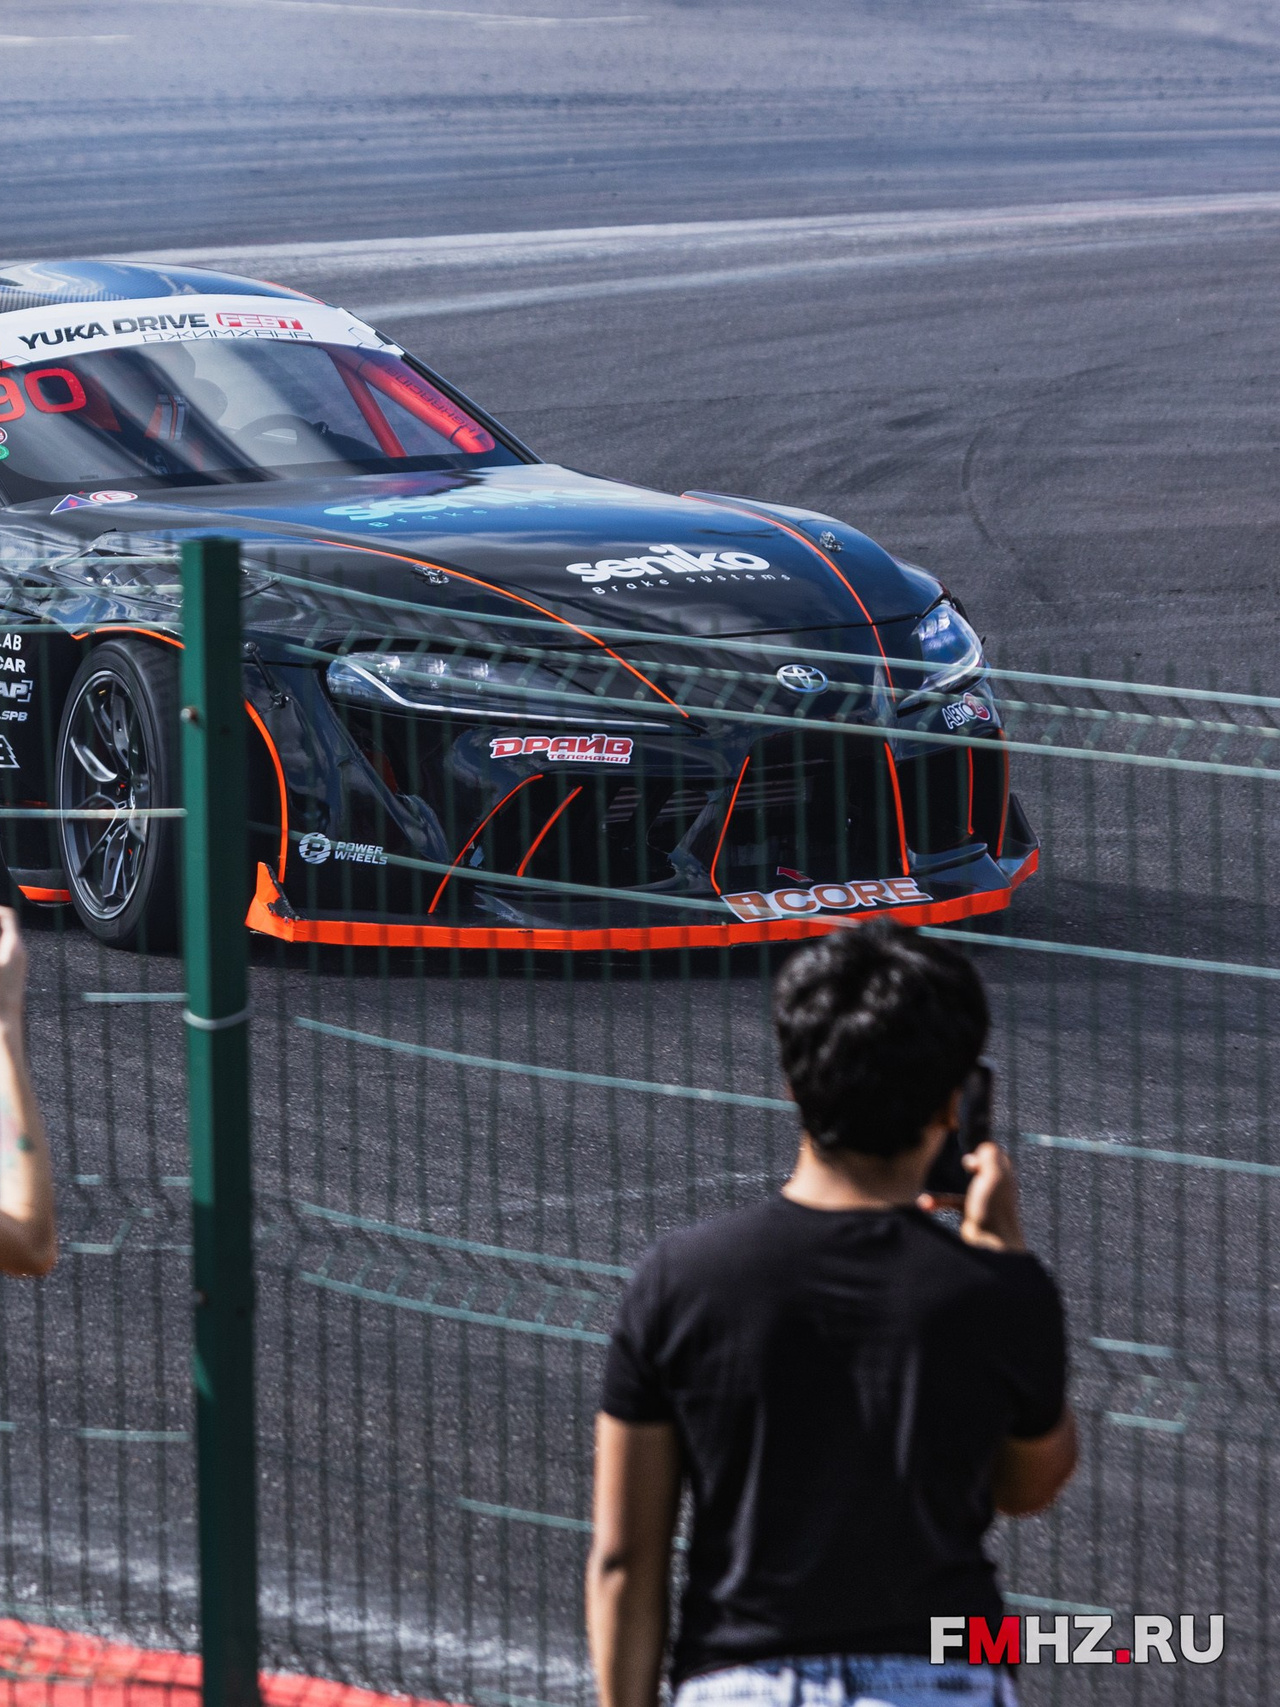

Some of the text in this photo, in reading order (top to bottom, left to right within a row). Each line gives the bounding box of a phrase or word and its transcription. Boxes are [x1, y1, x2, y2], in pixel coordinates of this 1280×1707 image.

[18, 313, 299, 350] YUKA DRIVE FEST
[141, 328, 314, 342] ДЖИМХАНА
[368, 509, 488, 528] Brake
[566, 544, 771, 582] seniko
[591, 574, 791, 595] Brake systems
[490, 735, 632, 756] ДРАЙВ
[334, 850, 389, 866] WHEELS
[336, 841, 384, 855] POWER
